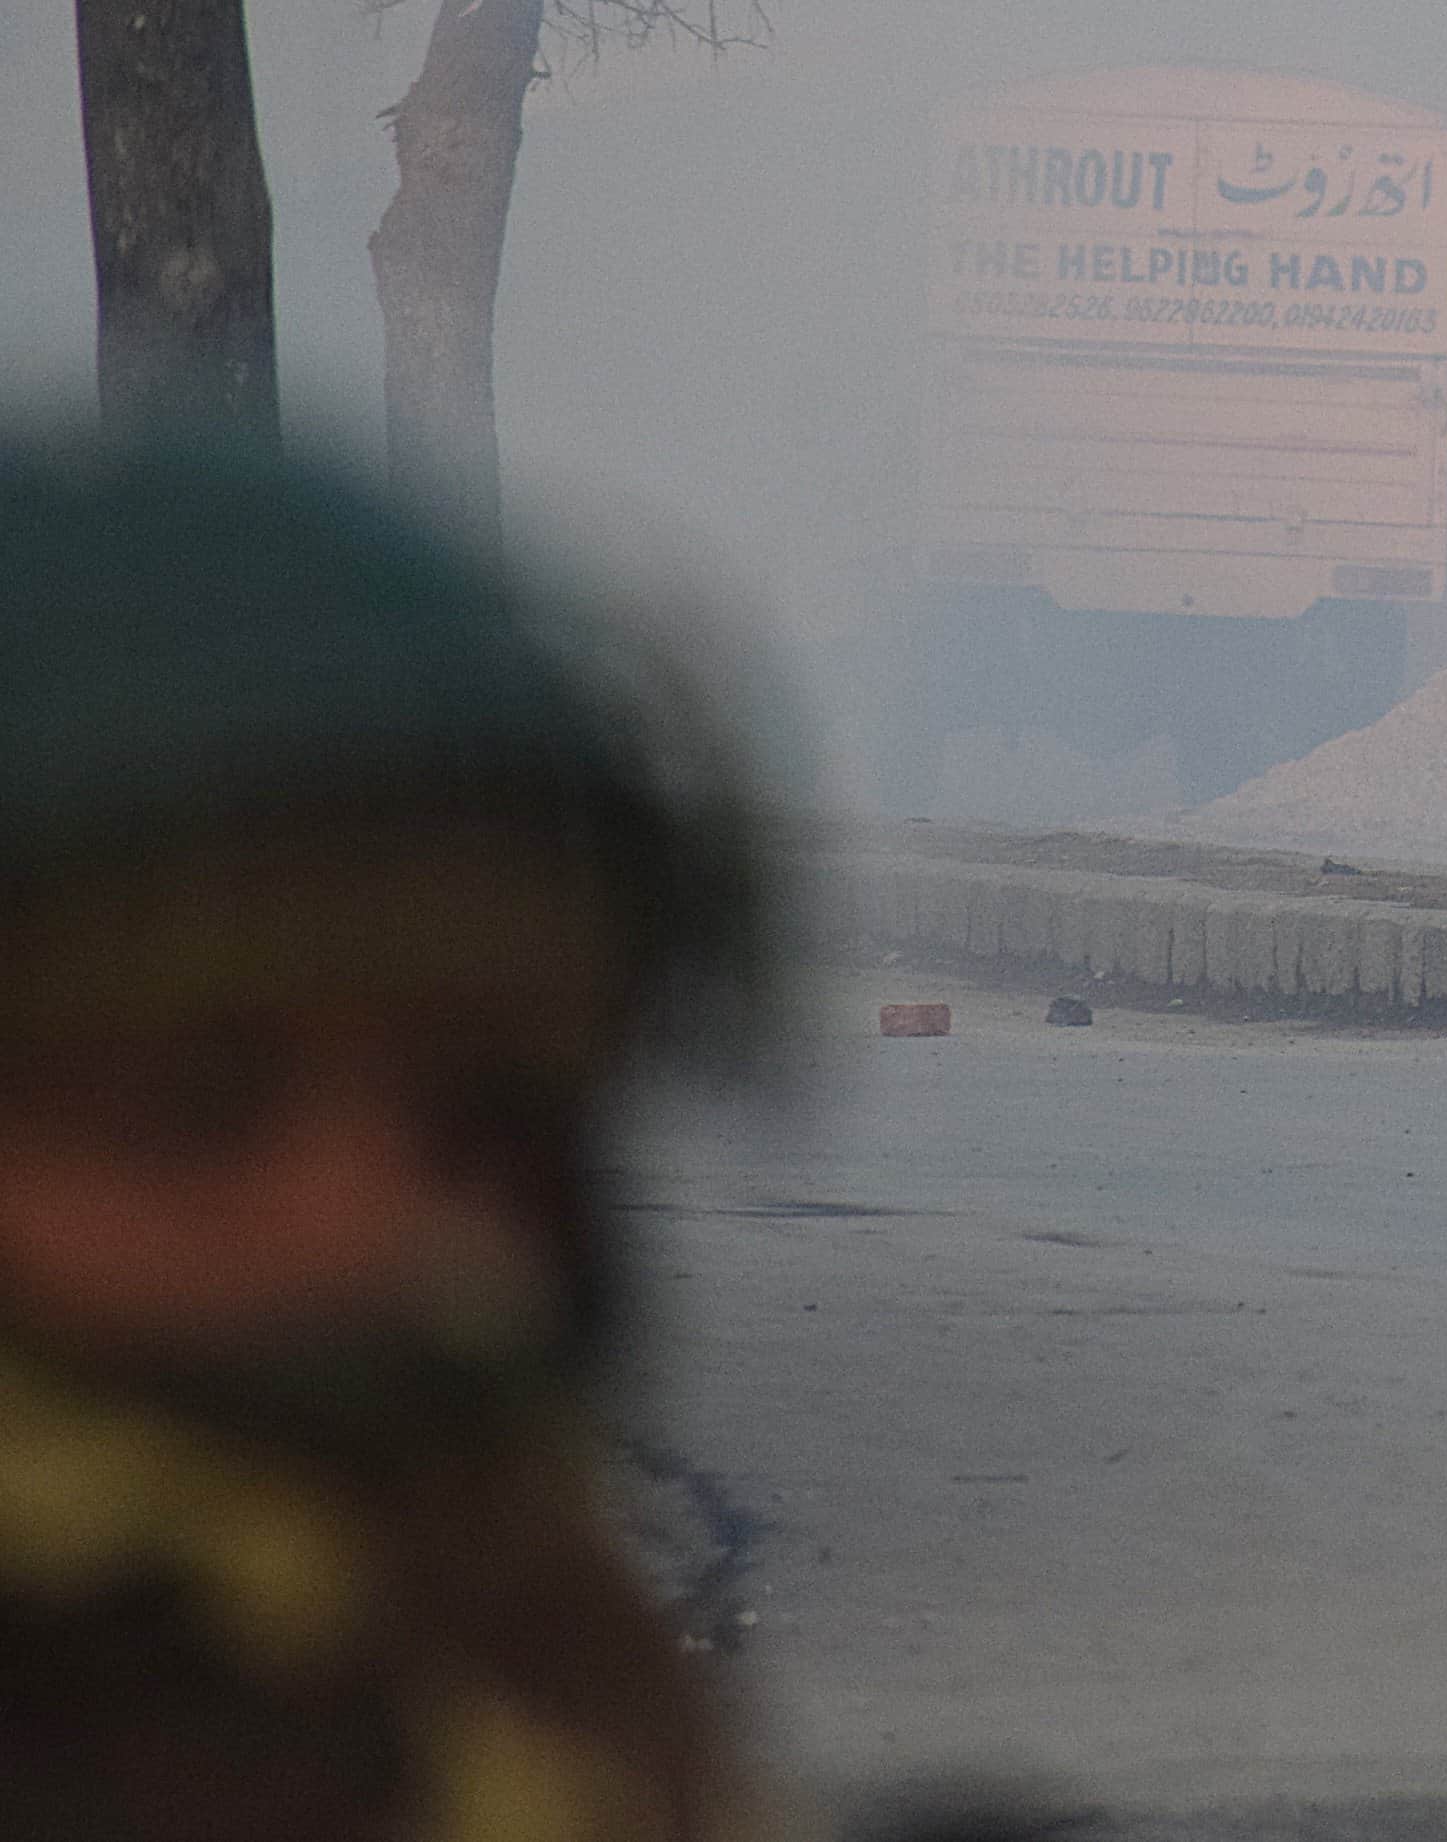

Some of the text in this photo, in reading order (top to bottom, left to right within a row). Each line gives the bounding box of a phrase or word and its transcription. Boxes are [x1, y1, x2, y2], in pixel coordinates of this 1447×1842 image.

[951, 143, 1173, 211] ATHROUT
[950, 238, 1041, 280] THE
[1268, 251, 1429, 295] HAND
